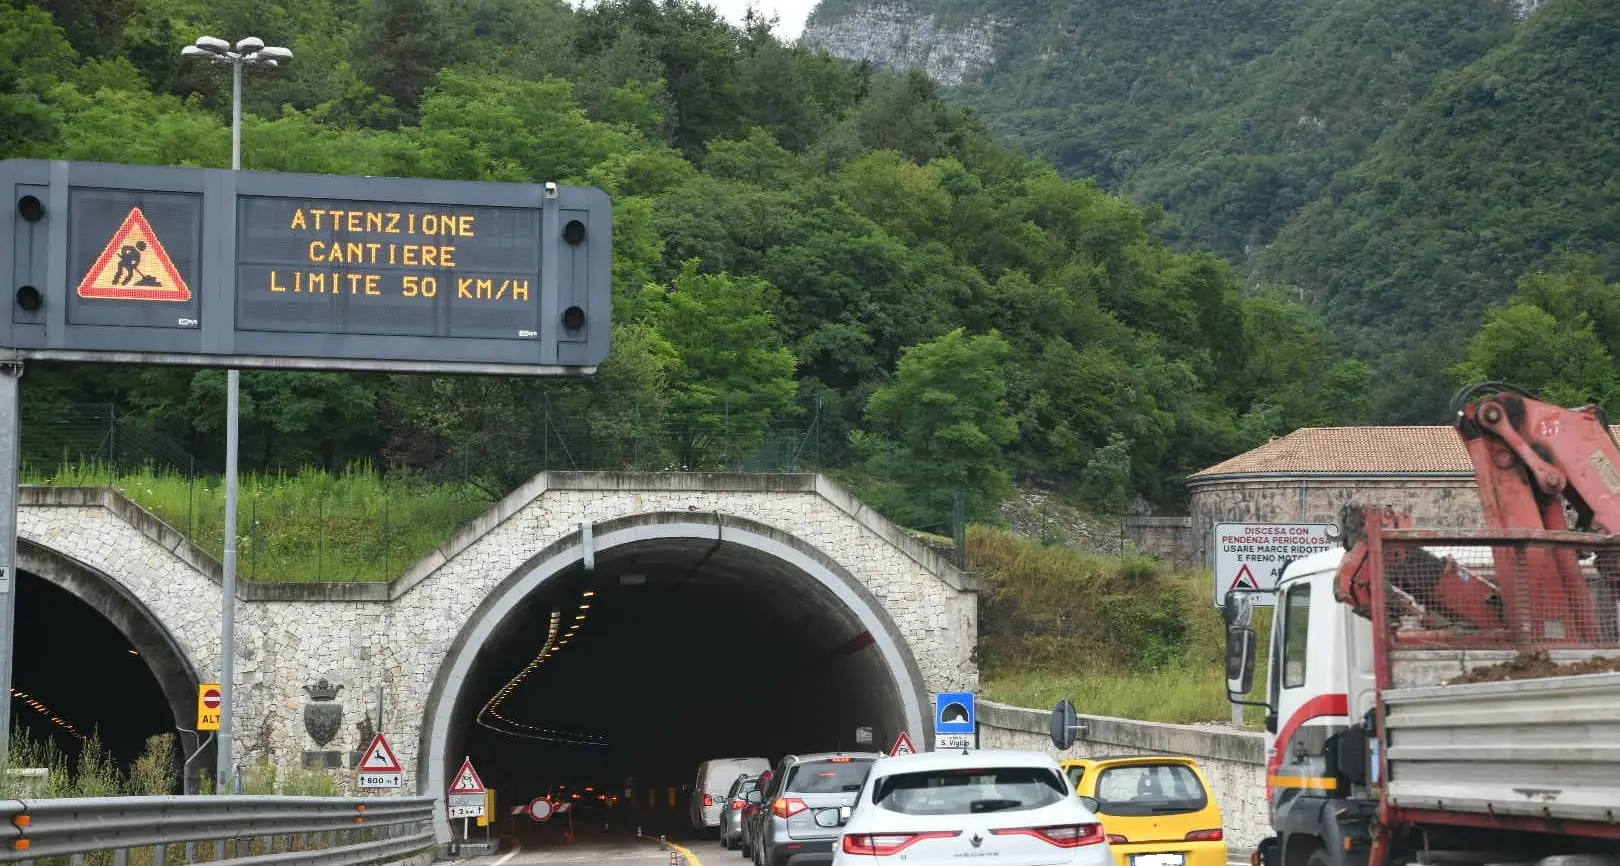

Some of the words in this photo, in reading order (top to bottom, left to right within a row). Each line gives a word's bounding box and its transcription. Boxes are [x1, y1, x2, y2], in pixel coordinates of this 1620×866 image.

[290, 208, 475, 237] ATTENZIONE
[309, 240, 456, 268] CANTIERE
[270, 270, 381, 296] LIMITE
[402, 275, 437, 297] 50
[458, 278, 529, 301] KM/H
[1244, 527, 1287, 535] DISCESA
[1222, 535, 1270, 544] PENDENZA
[1273, 536, 1332, 545] PERICOLOSA
[1223, 545, 1254, 553] USARE
[1257, 545, 1288, 554] MARCE
[1246, 554, 1275, 563] FRENO
